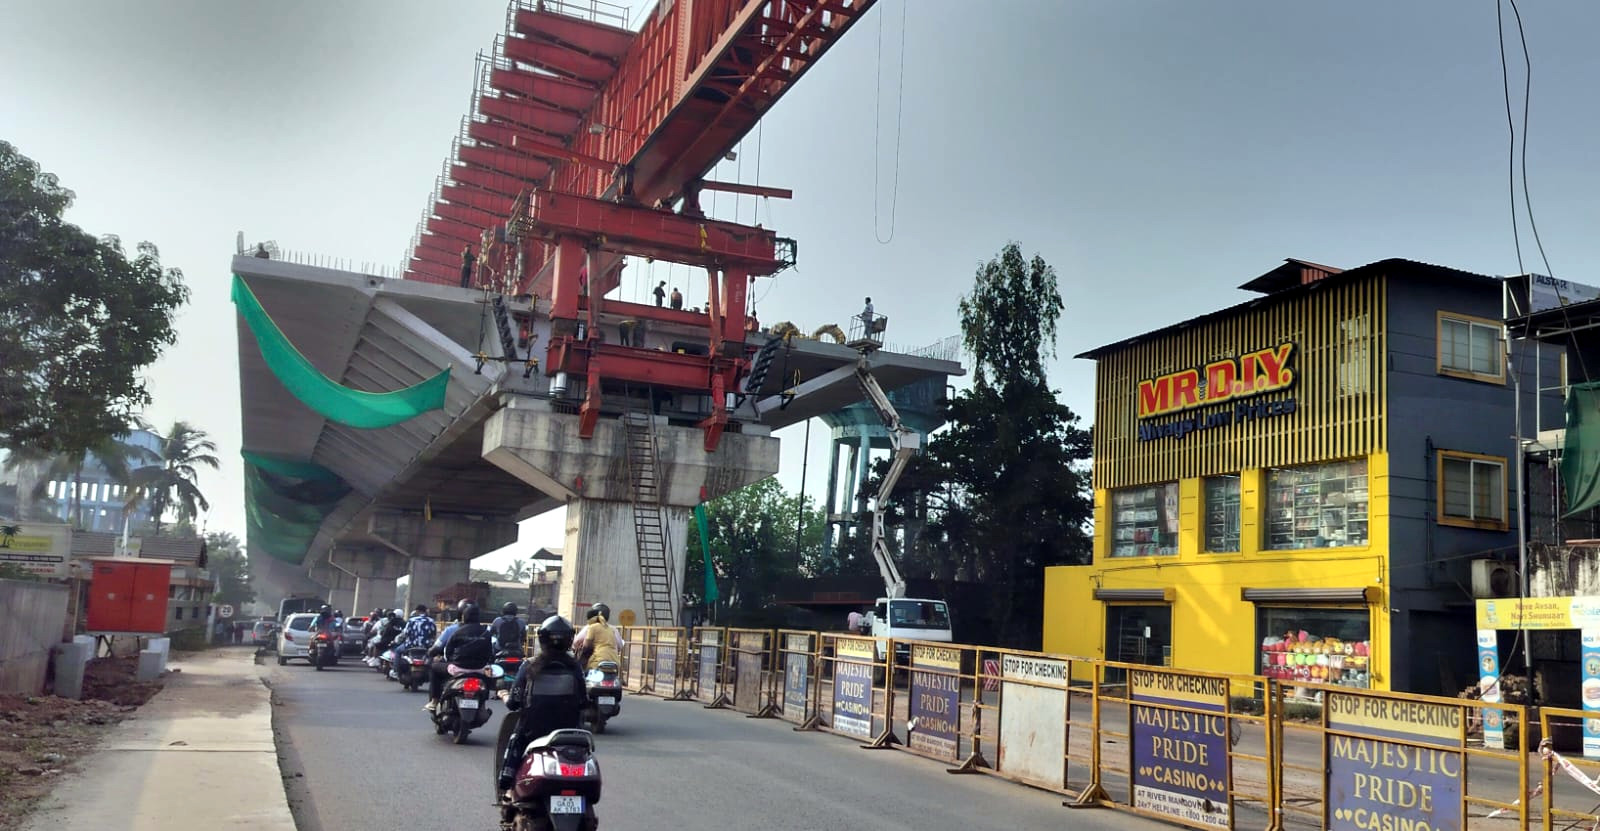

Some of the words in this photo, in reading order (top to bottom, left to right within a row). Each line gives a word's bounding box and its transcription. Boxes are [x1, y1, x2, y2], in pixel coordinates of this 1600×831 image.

[1206, 343, 1294, 403] D.I.Y.
[1138, 417, 1194, 441] Always
[1195, 410, 1233, 431] Low
[1235, 397, 1297, 423] Prices
[913, 671, 959, 693] MAJESTIC
[1004, 658, 1020, 673] STOP
[1021, 660, 1033, 675] FOR
[1034, 662, 1067, 680] CHECKING
[841, 680, 864, 698] PRIDE
[1133, 671, 1154, 688] STOP
[1157, 674, 1175, 691] FOR
[1176, 676, 1225, 697] CHECKING
[841, 700, 862, 715] CASINO
[920, 694, 949, 714] PRIDE
[1331, 694, 1360, 715] STOP
[1363, 698, 1388, 719] FOR
[1391, 700, 1460, 729] CHECKING
[920, 716, 948, 733] CASINO
[1136, 706, 1225, 737] MAJESTIC
[1152, 735, 1209, 766] PRIDE
[1332, 736, 1458, 778] MAJESTIC
[1153, 765, 1207, 791] CASINO
[1147, 791, 1166, 801] RIVER
[1353, 772, 1433, 812] PRIDE
